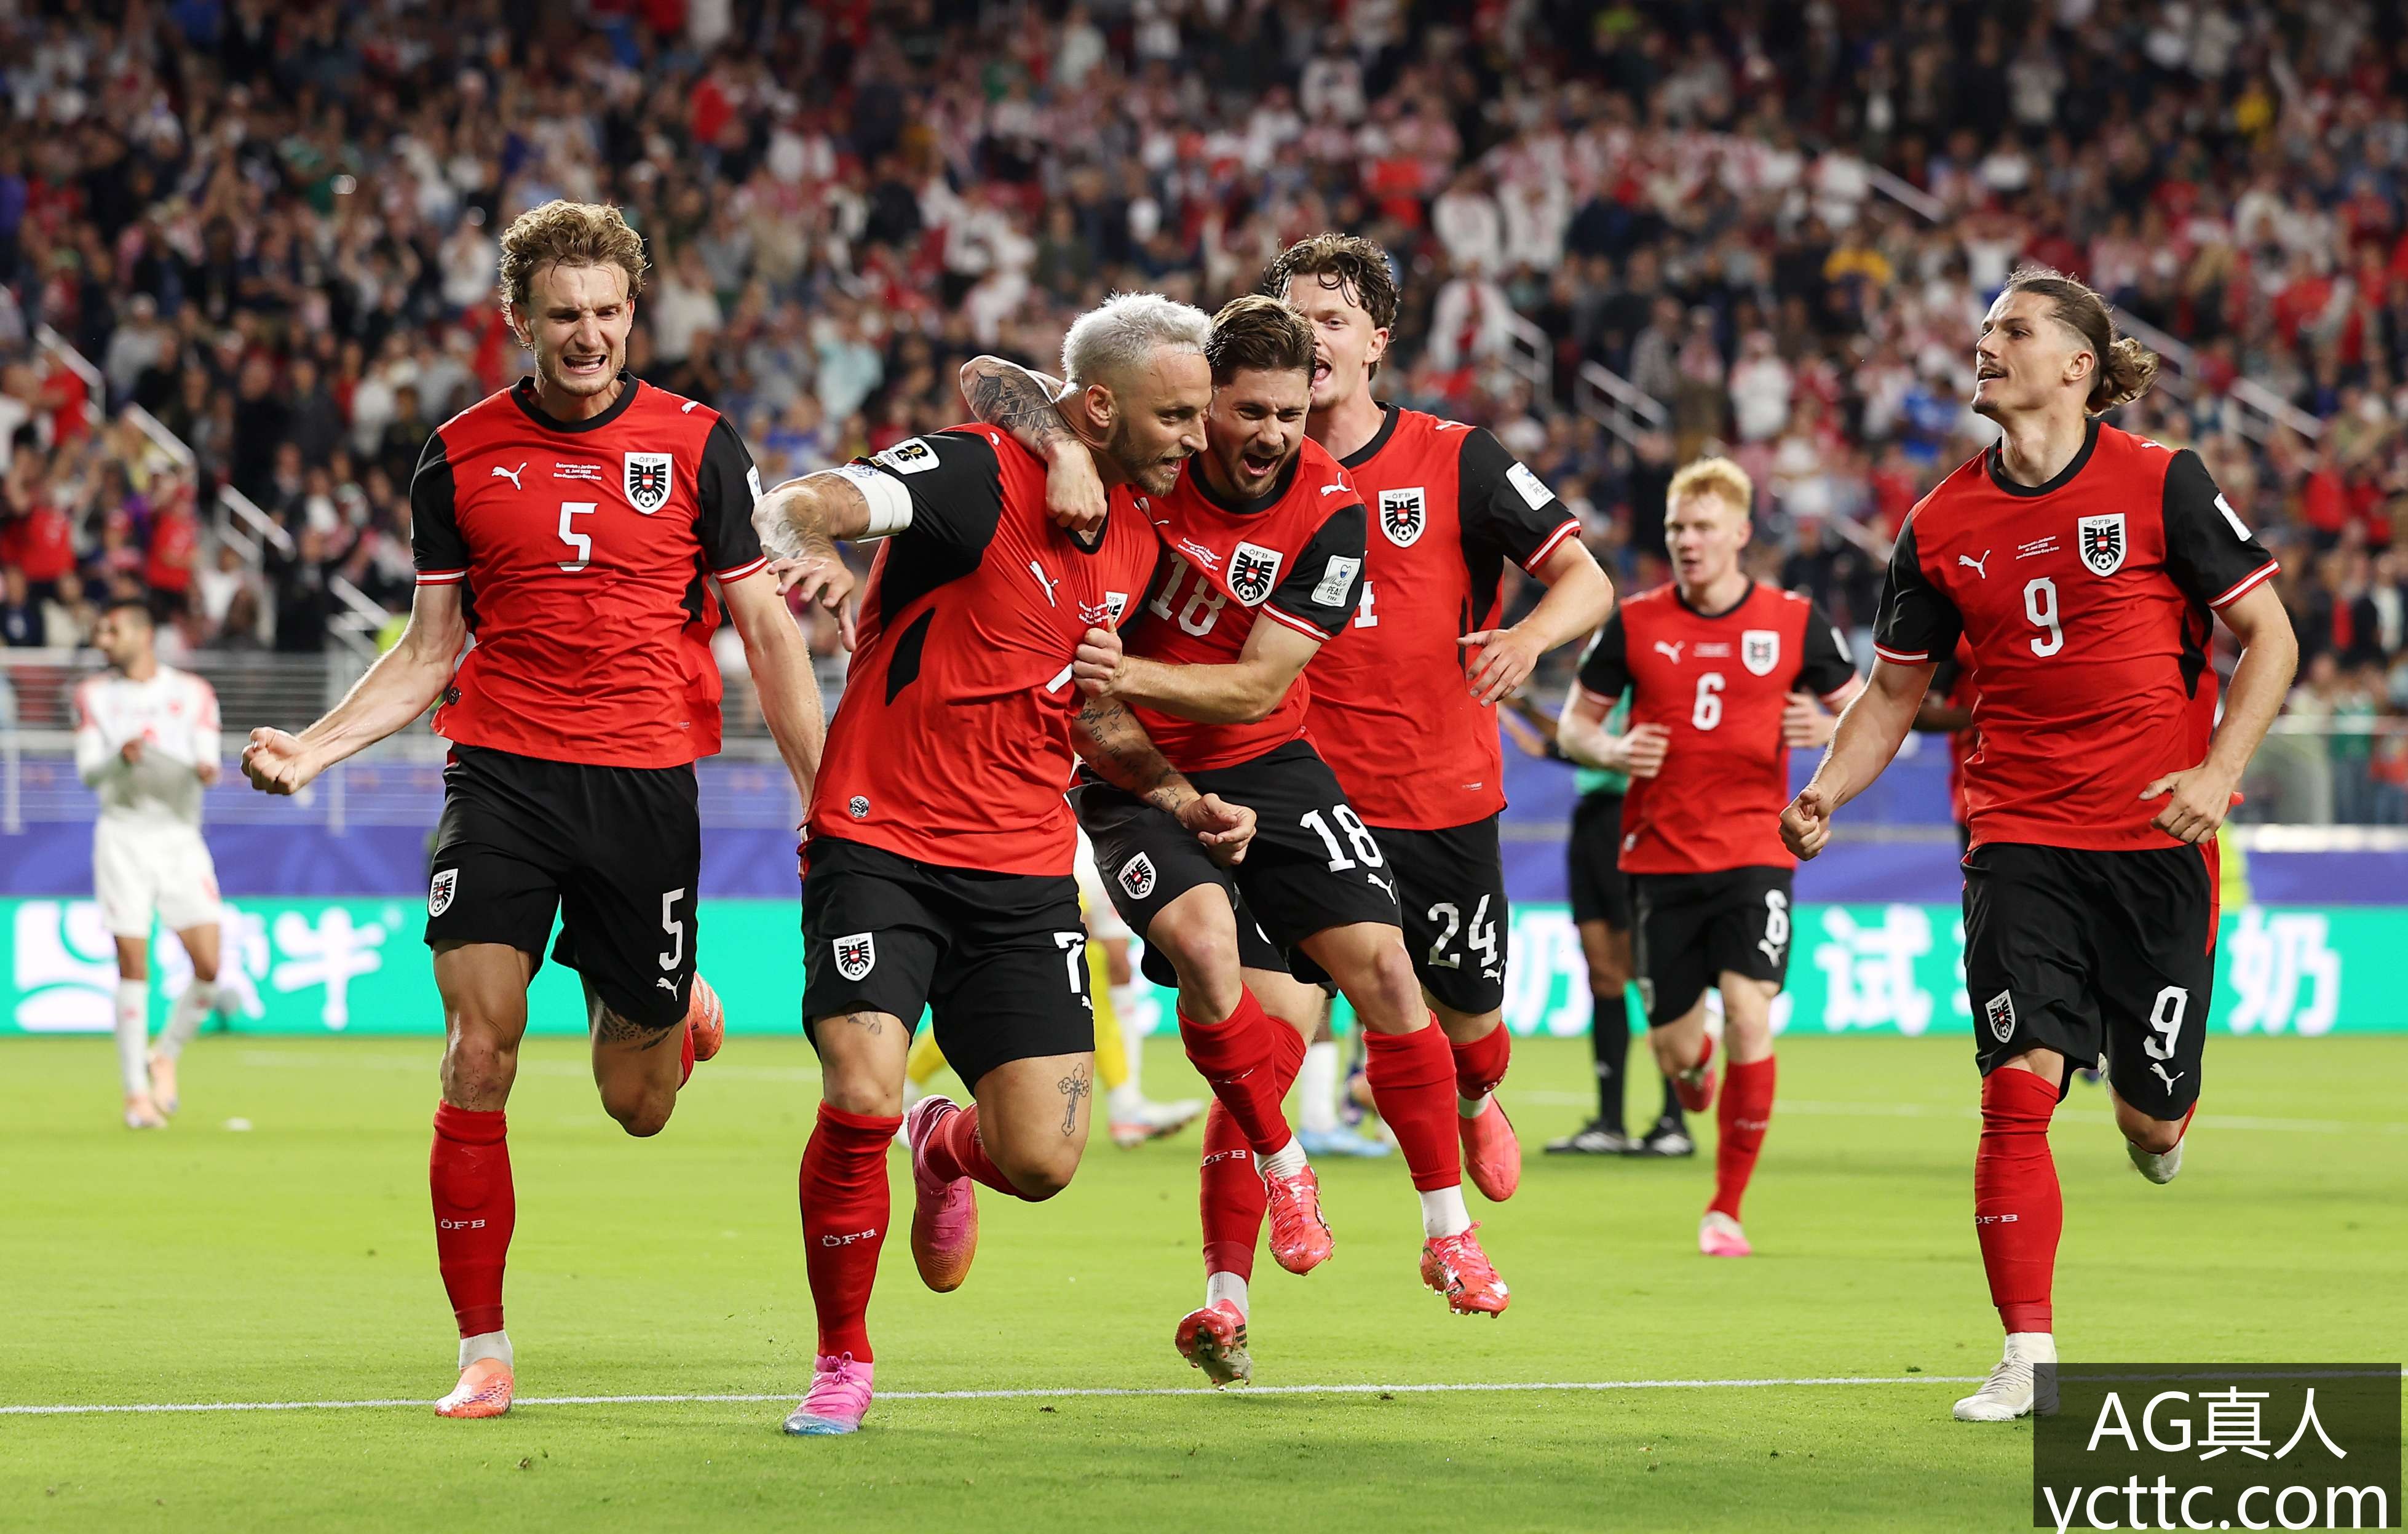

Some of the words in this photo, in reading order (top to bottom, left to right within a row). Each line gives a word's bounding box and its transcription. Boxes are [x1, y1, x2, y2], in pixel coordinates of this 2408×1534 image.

[557, 501, 598, 572] 5
[1149, 552, 1227, 637] 18
[2023, 576, 2064, 658] 9
[1692, 673, 1725, 730] 6
[1300, 804, 1385, 872] 18
[659, 888, 685, 971] 5
[1428, 894, 1497, 970] 24
[1764, 889, 1789, 945] 6
[1053, 932, 1085, 993] 7
[2227, 904, 2341, 1037] 奶
[2144, 985, 2188, 1060] 9
[440, 1218, 485, 1230] ÖFB
[822, 1228, 877, 1247] ÖFB
